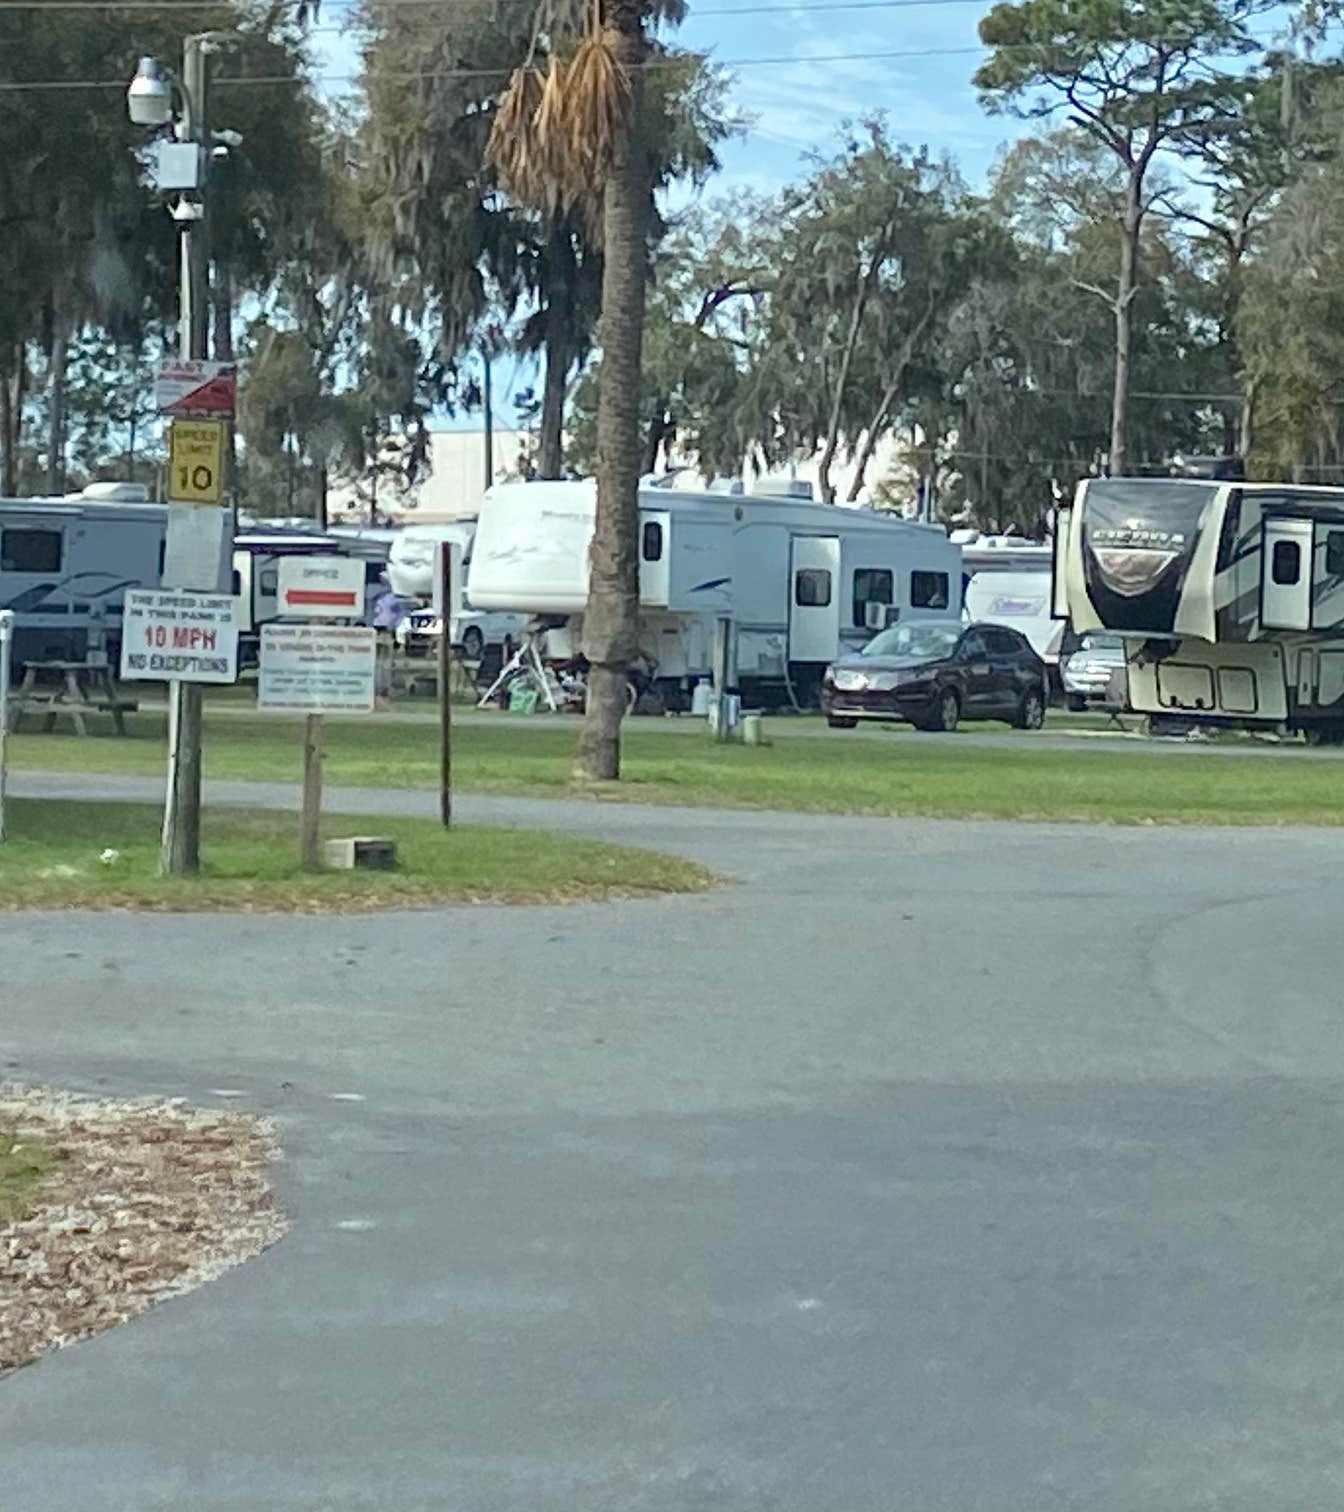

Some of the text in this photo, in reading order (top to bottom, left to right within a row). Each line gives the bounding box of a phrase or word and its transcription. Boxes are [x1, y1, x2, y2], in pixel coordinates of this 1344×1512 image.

[178, 464, 212, 491] 10
[145, 625, 217, 650] 10 MPH
[128, 653, 228, 674] NO EXCEPTIONS
